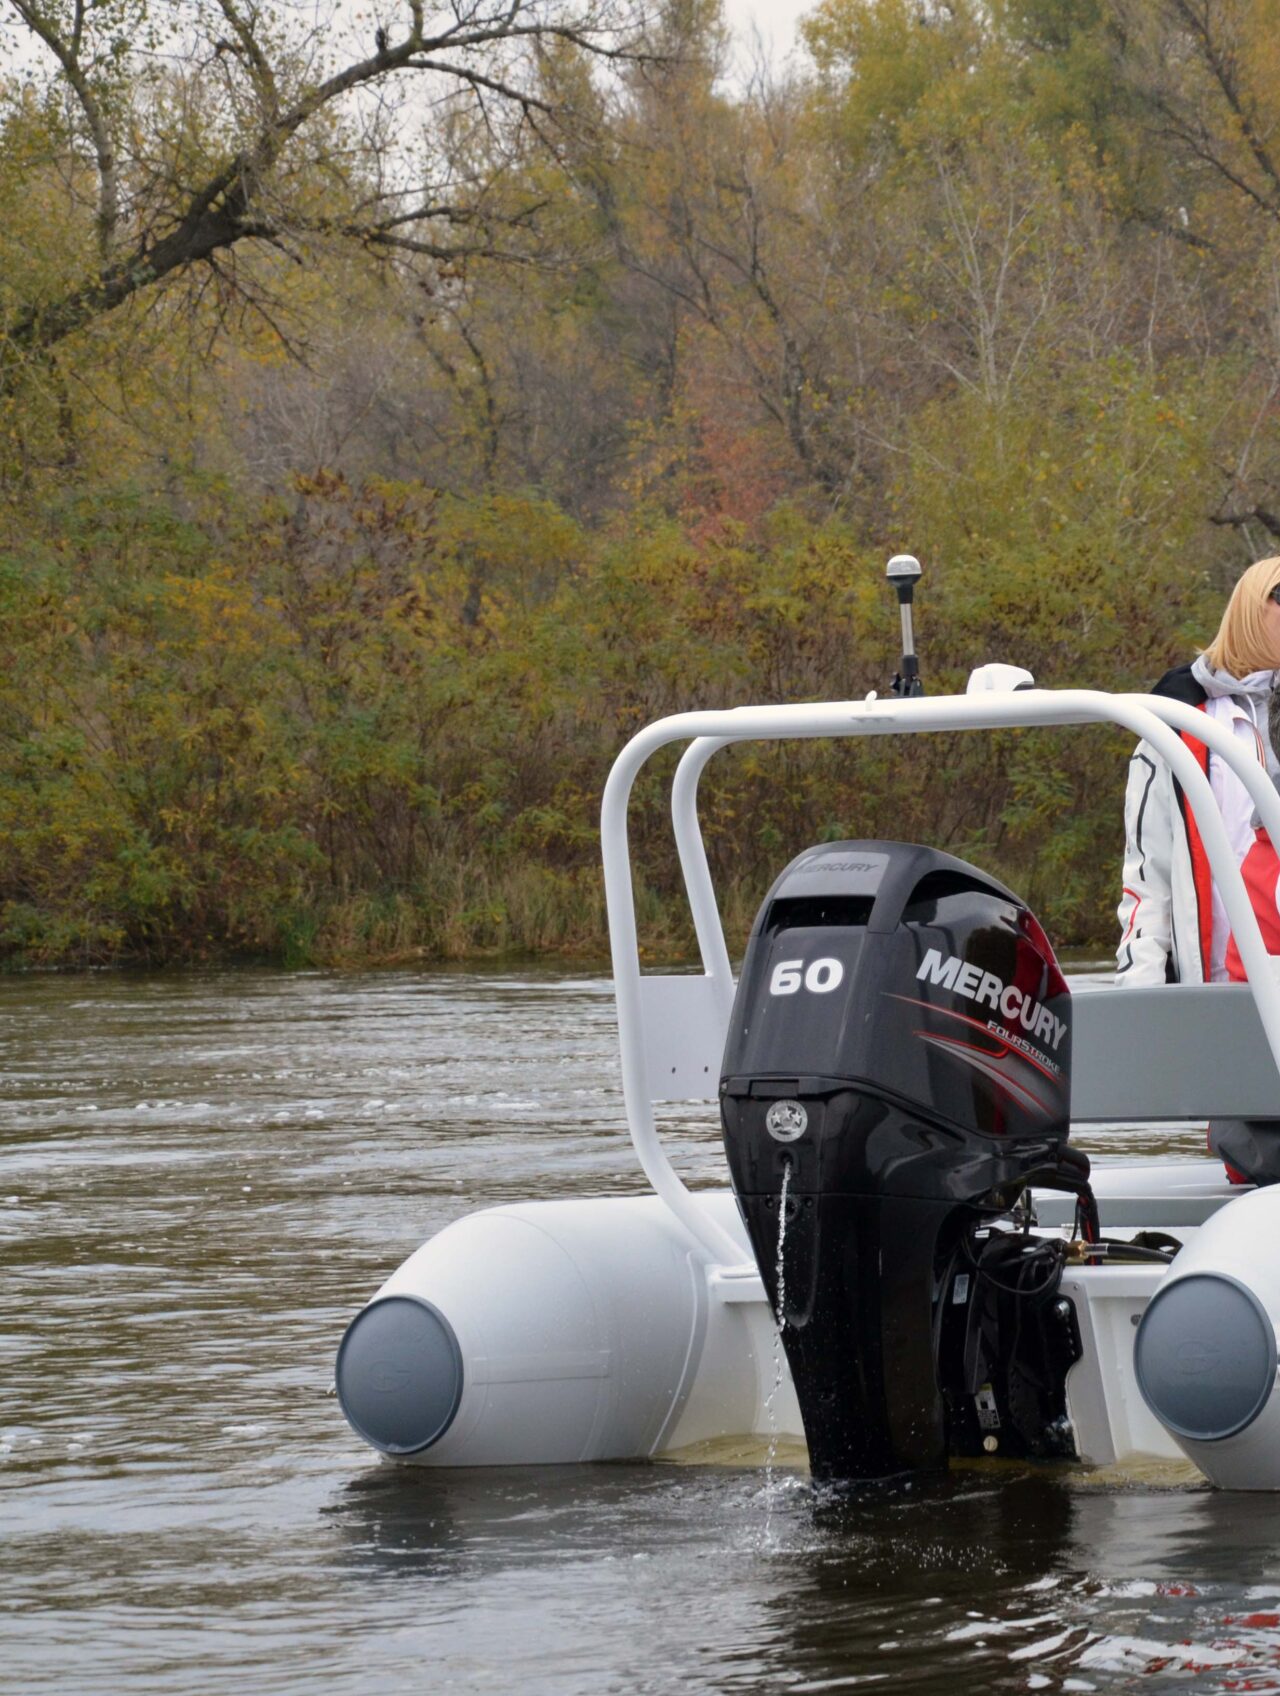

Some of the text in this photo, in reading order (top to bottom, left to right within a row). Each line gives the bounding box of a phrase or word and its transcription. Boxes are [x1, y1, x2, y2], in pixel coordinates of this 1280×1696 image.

[769, 957, 843, 995] 60
[915, 948, 1068, 1051] MERCURY
[986, 1019, 1061, 1073] FOURSTROKE
